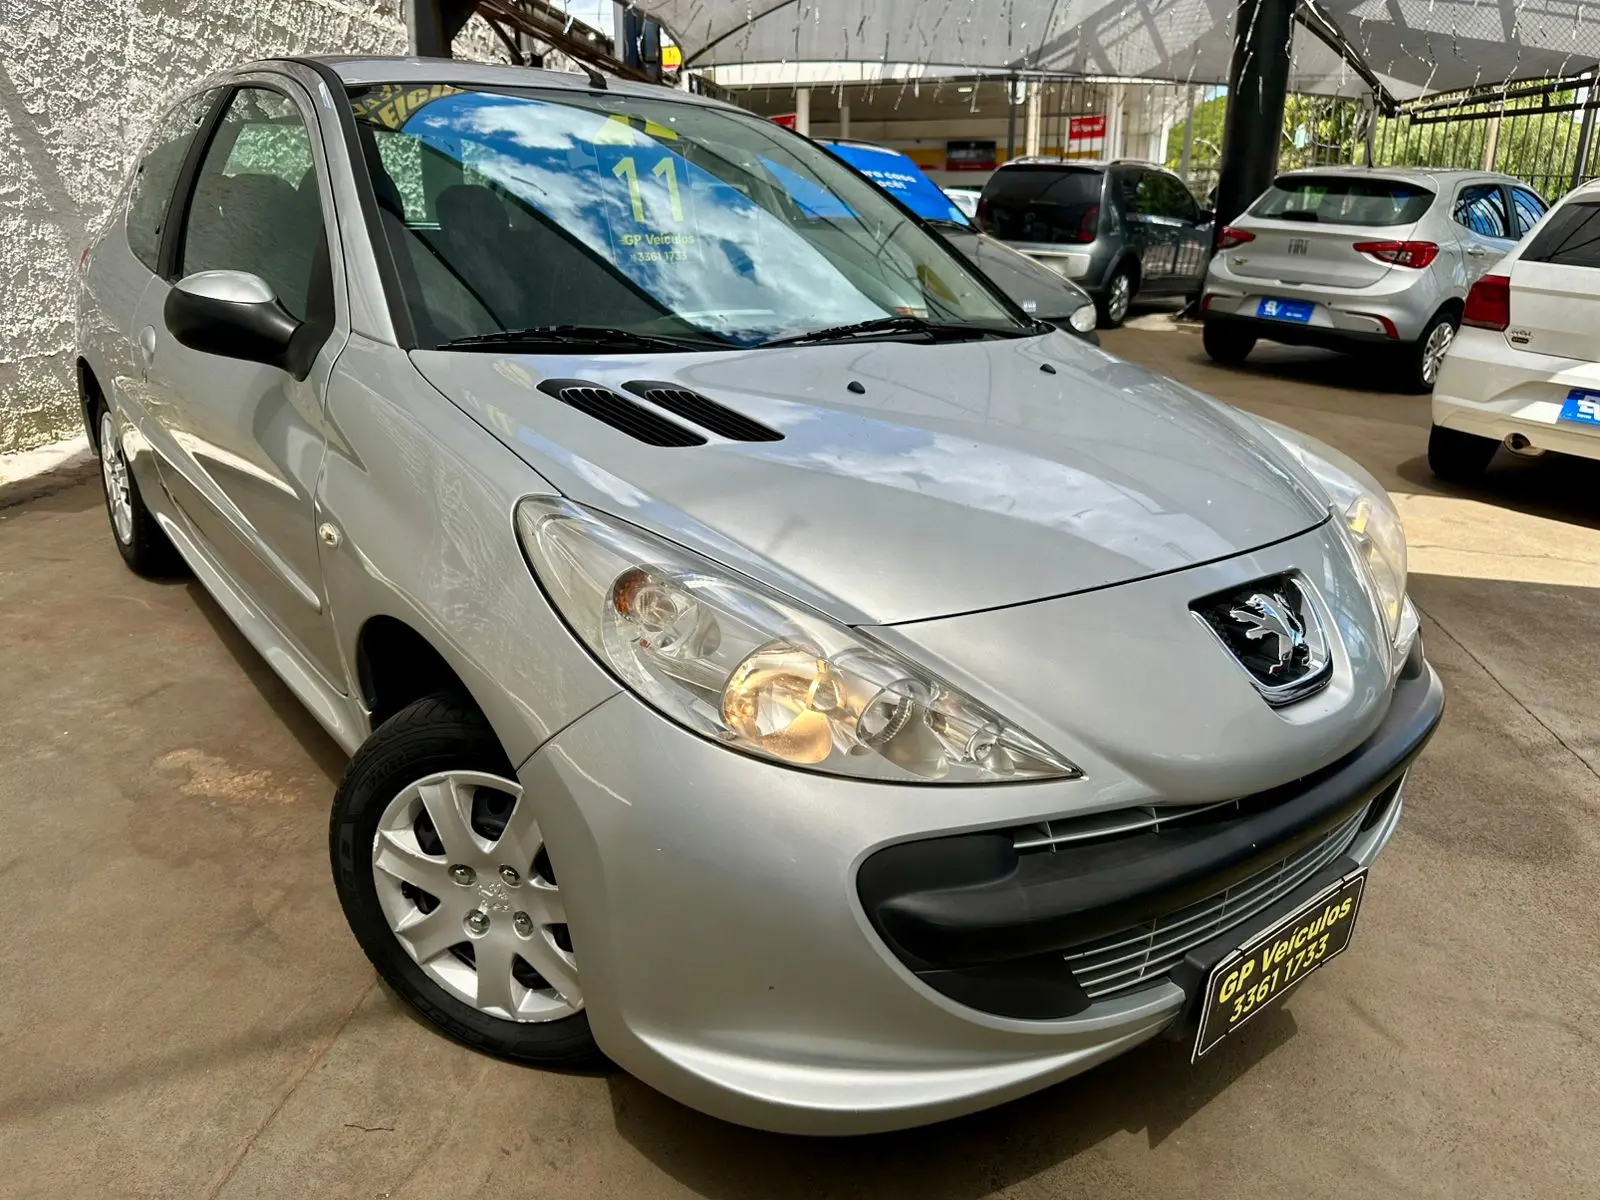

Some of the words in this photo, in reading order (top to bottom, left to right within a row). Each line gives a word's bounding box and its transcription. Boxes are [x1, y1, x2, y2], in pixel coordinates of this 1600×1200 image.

[612, 157, 684, 223] 11
[624, 234, 642, 246] GP
[645, 233, 695, 246] Veículos
[1219, 959, 1255, 1003] GP
[1262, 897, 1352, 973] Veículos
[1229, 967, 1280, 1022] 3361
[1284, 932, 1330, 982] 1733
